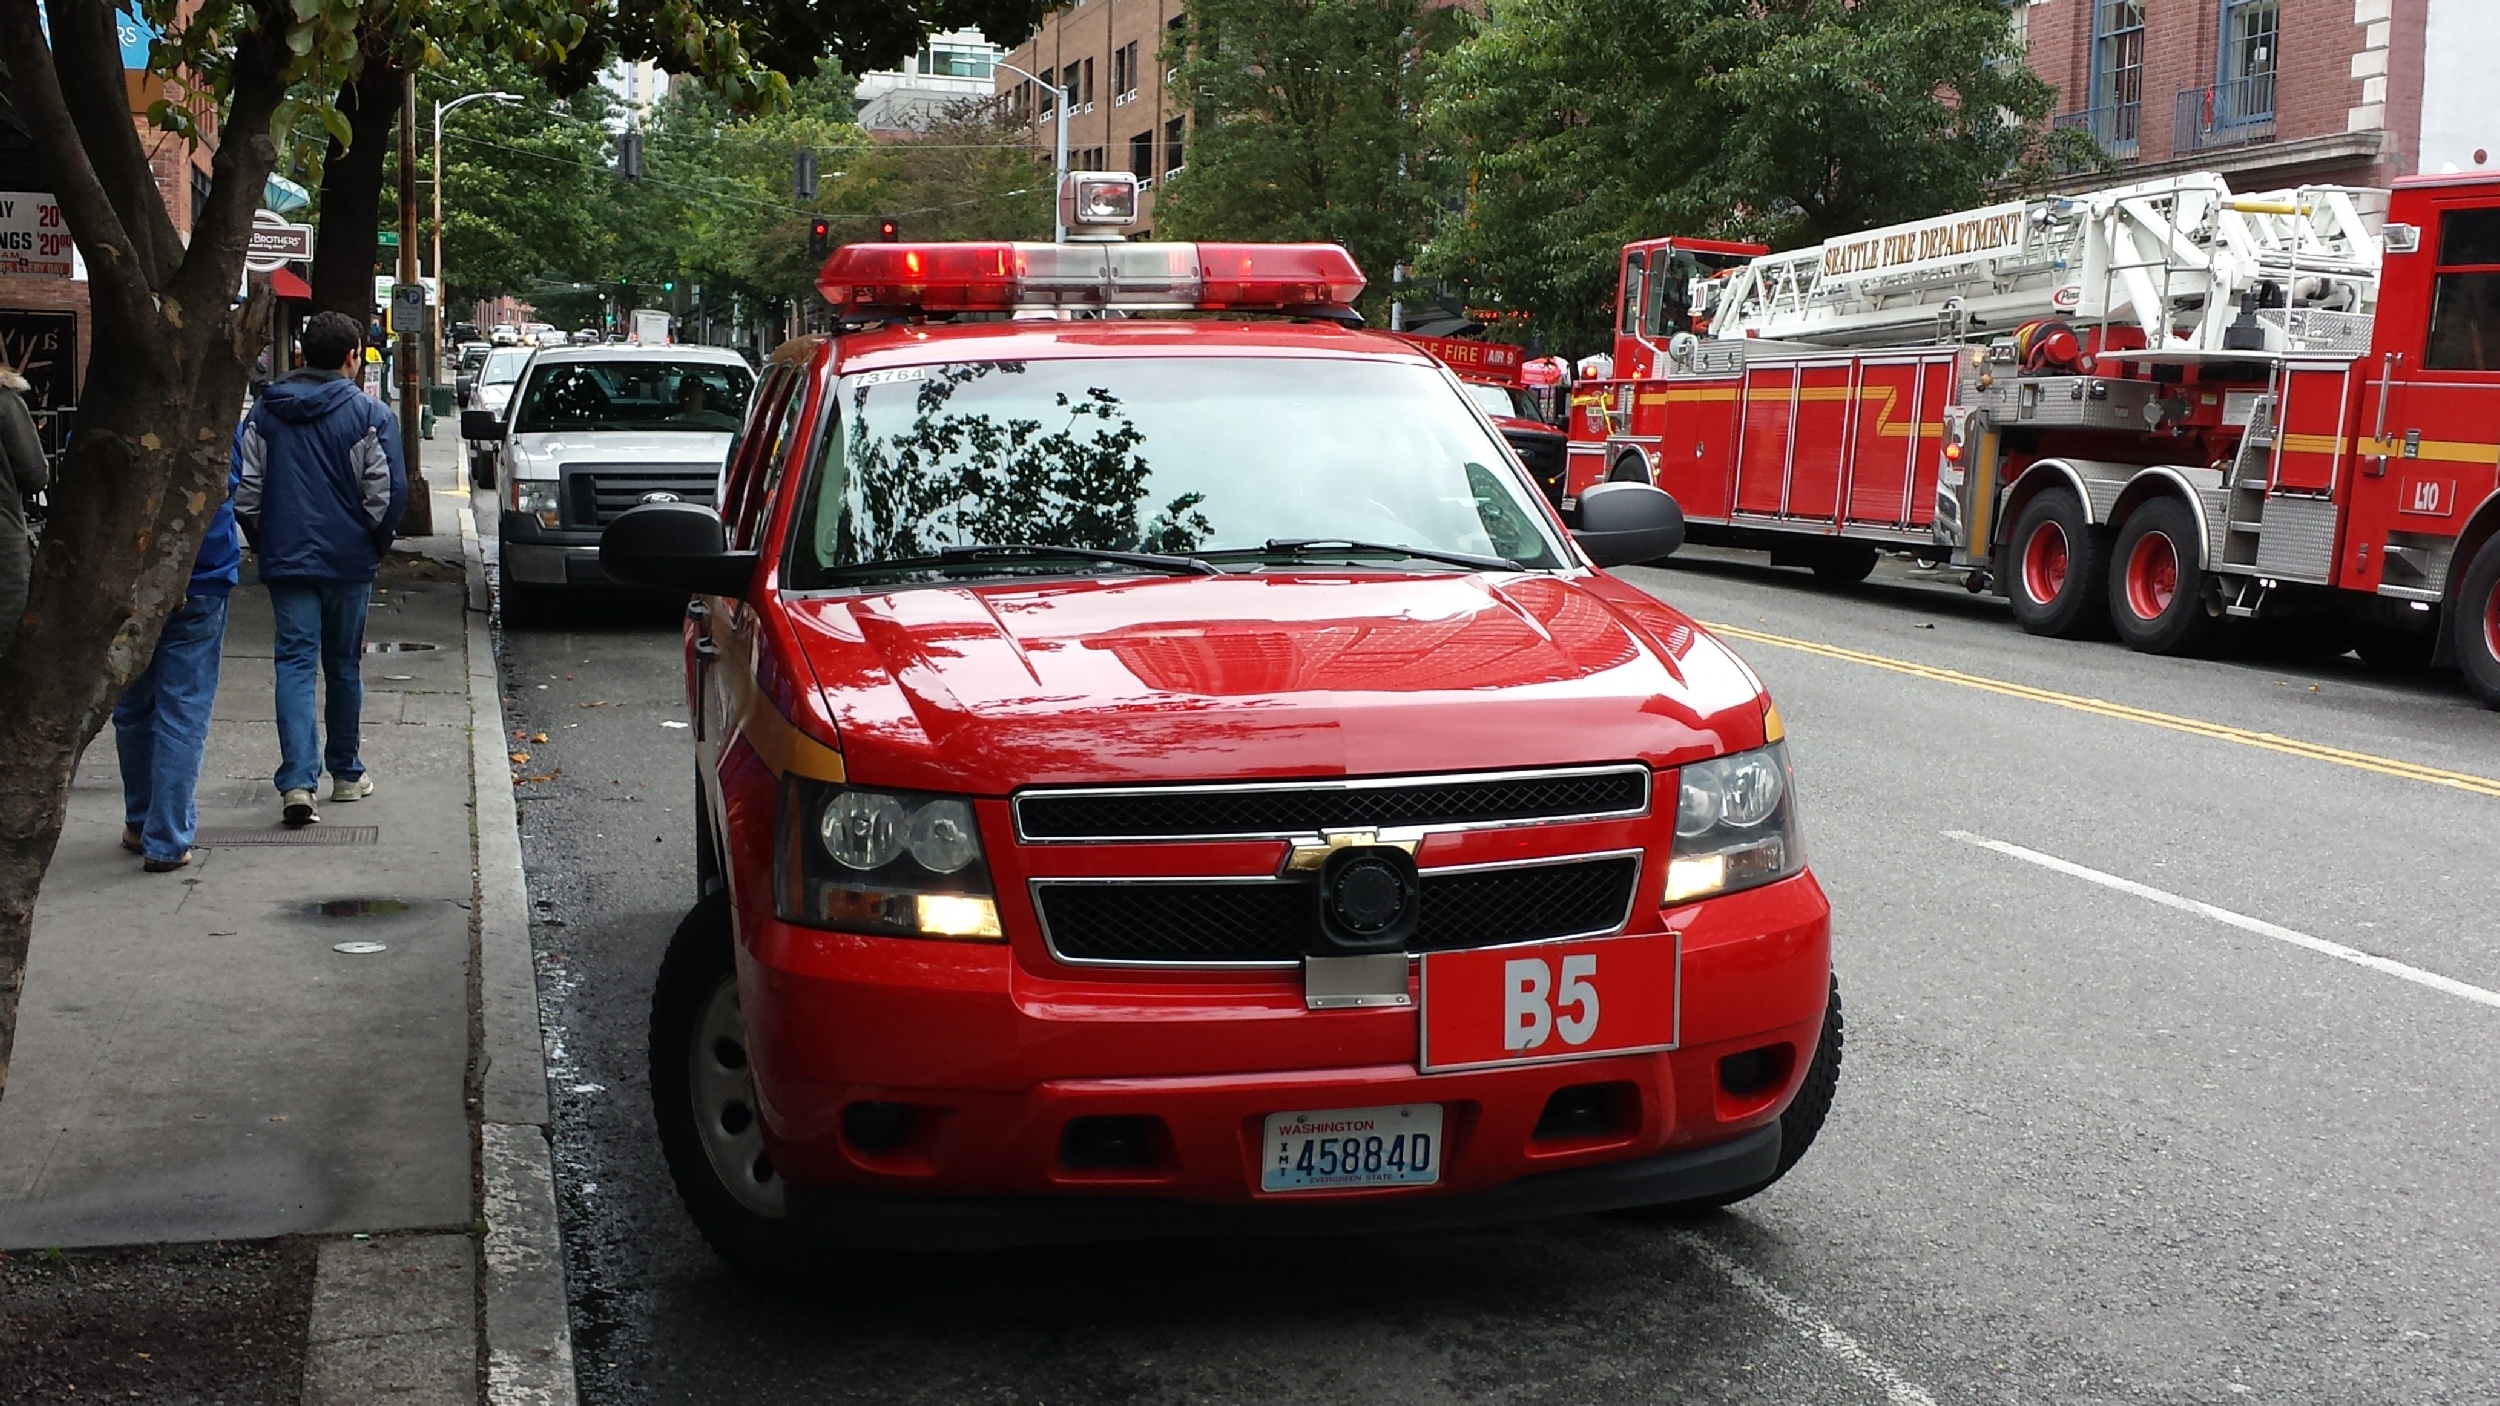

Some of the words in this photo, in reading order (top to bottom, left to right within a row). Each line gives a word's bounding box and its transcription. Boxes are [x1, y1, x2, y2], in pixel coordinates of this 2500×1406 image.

[1824, 238, 1879, 276] SEATTLE
[1881, 231, 1916, 267] FIRE
[1918, 211, 2021, 261] DEPARTMENT
[1445, 344, 1478, 363] FIRE
[1488, 350, 1503, 364] AIR
[1507, 351, 1514, 365] 9
[855, 369, 922, 386] 73764
[2414, 481, 2439, 511] L10
[1504, 953, 1600, 1051] B5
[1279, 1120, 1374, 1136] WASHINGTON
[1296, 1133, 1431, 1177] 45884D
[1310, 1174, 1362, 1184] EVERGREEN
[1366, 1173, 1392, 1182] STATE
